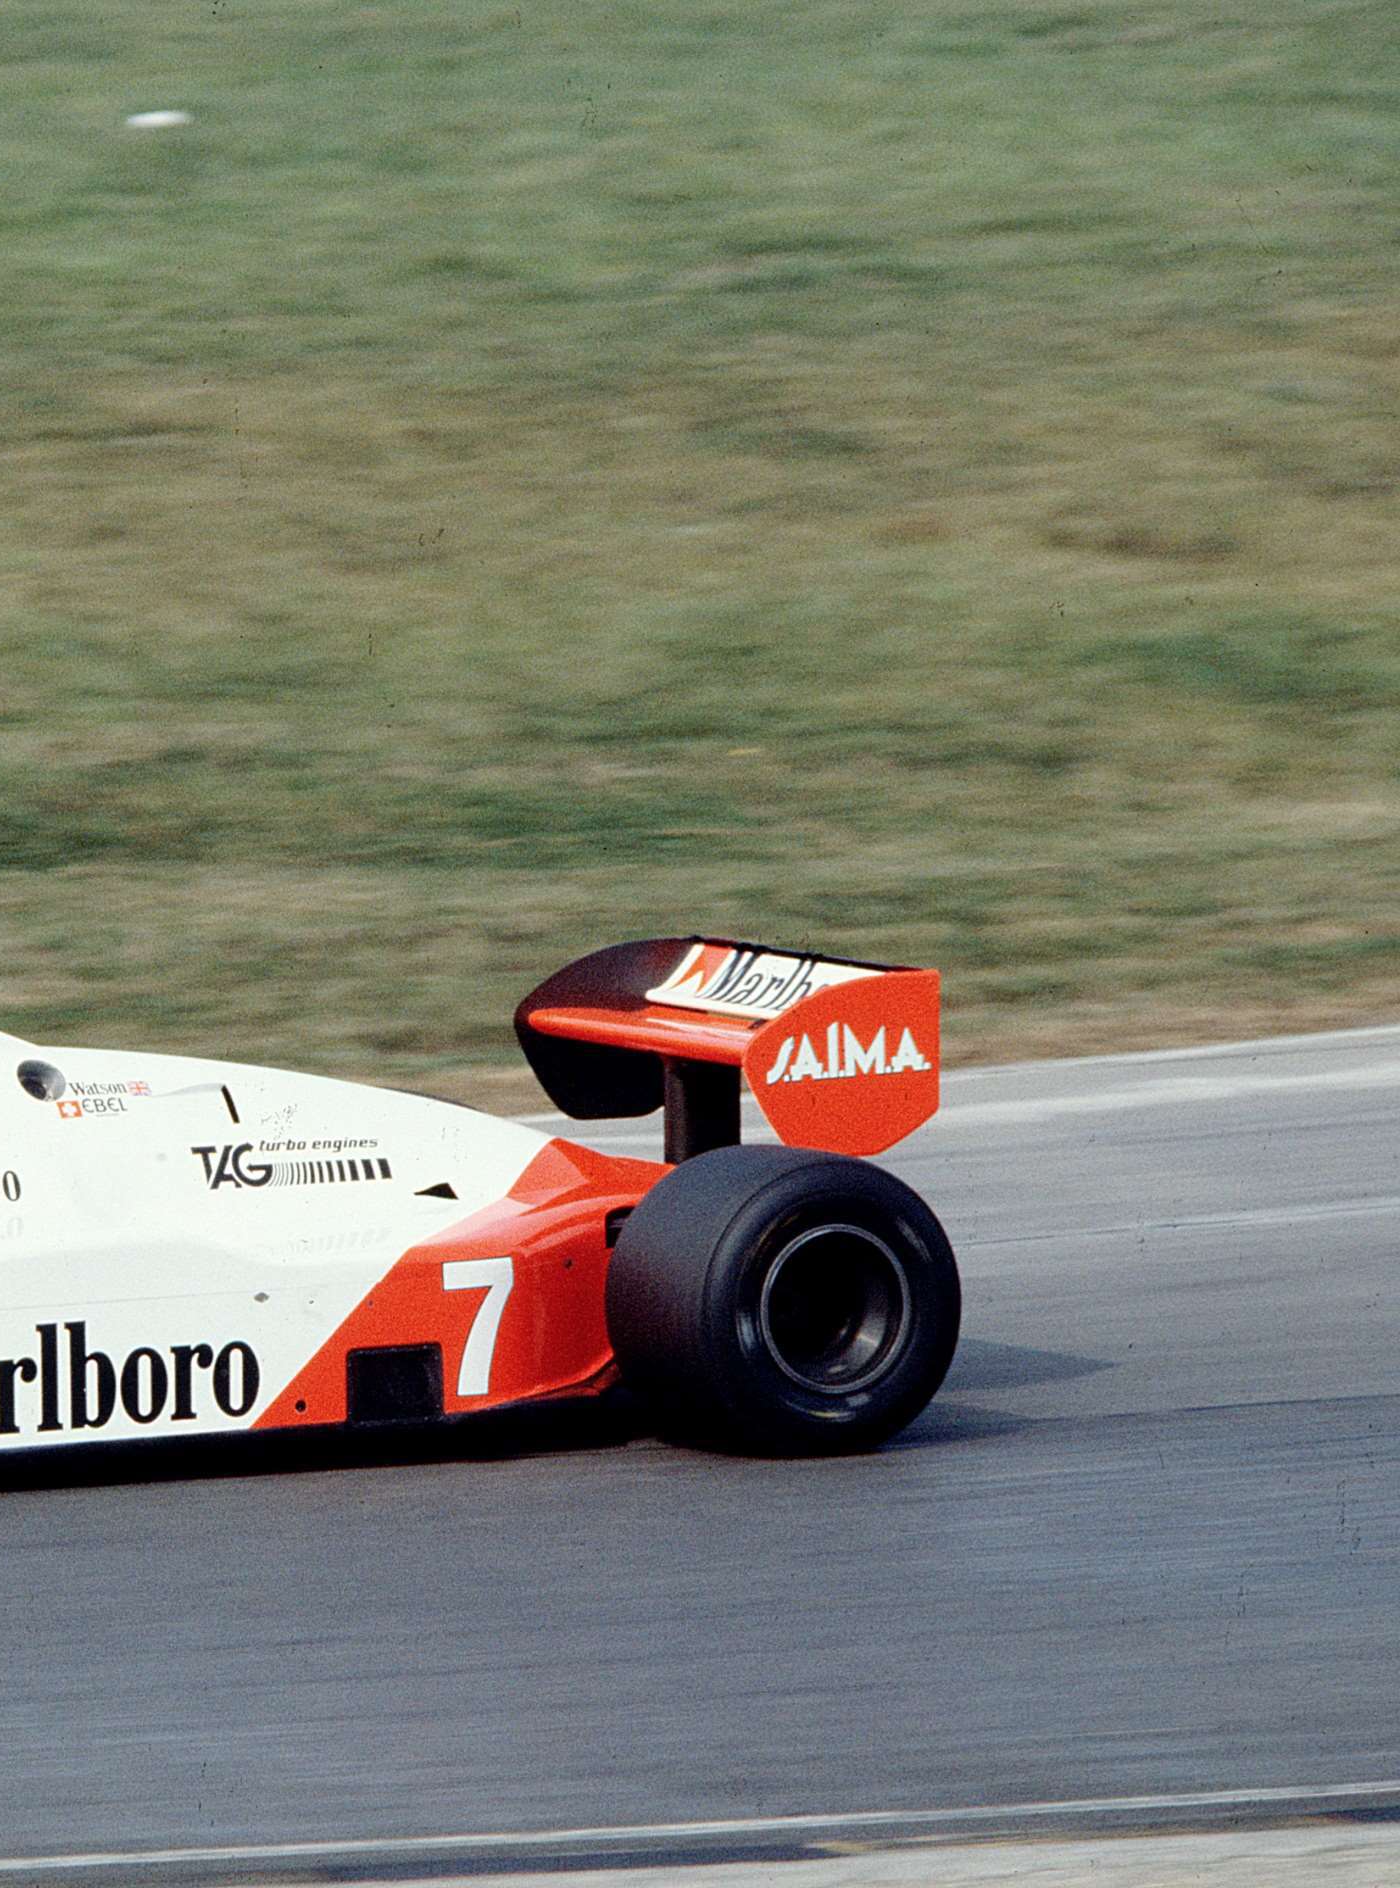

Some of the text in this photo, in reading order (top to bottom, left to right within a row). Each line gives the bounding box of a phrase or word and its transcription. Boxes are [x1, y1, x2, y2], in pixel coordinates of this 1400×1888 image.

[697, 950, 829, 1010] Marlb
[68, 1081, 128, 1096] Watson
[81, 1097, 128, 1113] EBEL
[258, 1137, 379, 1153] turbo engines
[190, 1142, 274, 1190] TAG
[442, 1256, 513, 1397] 7
